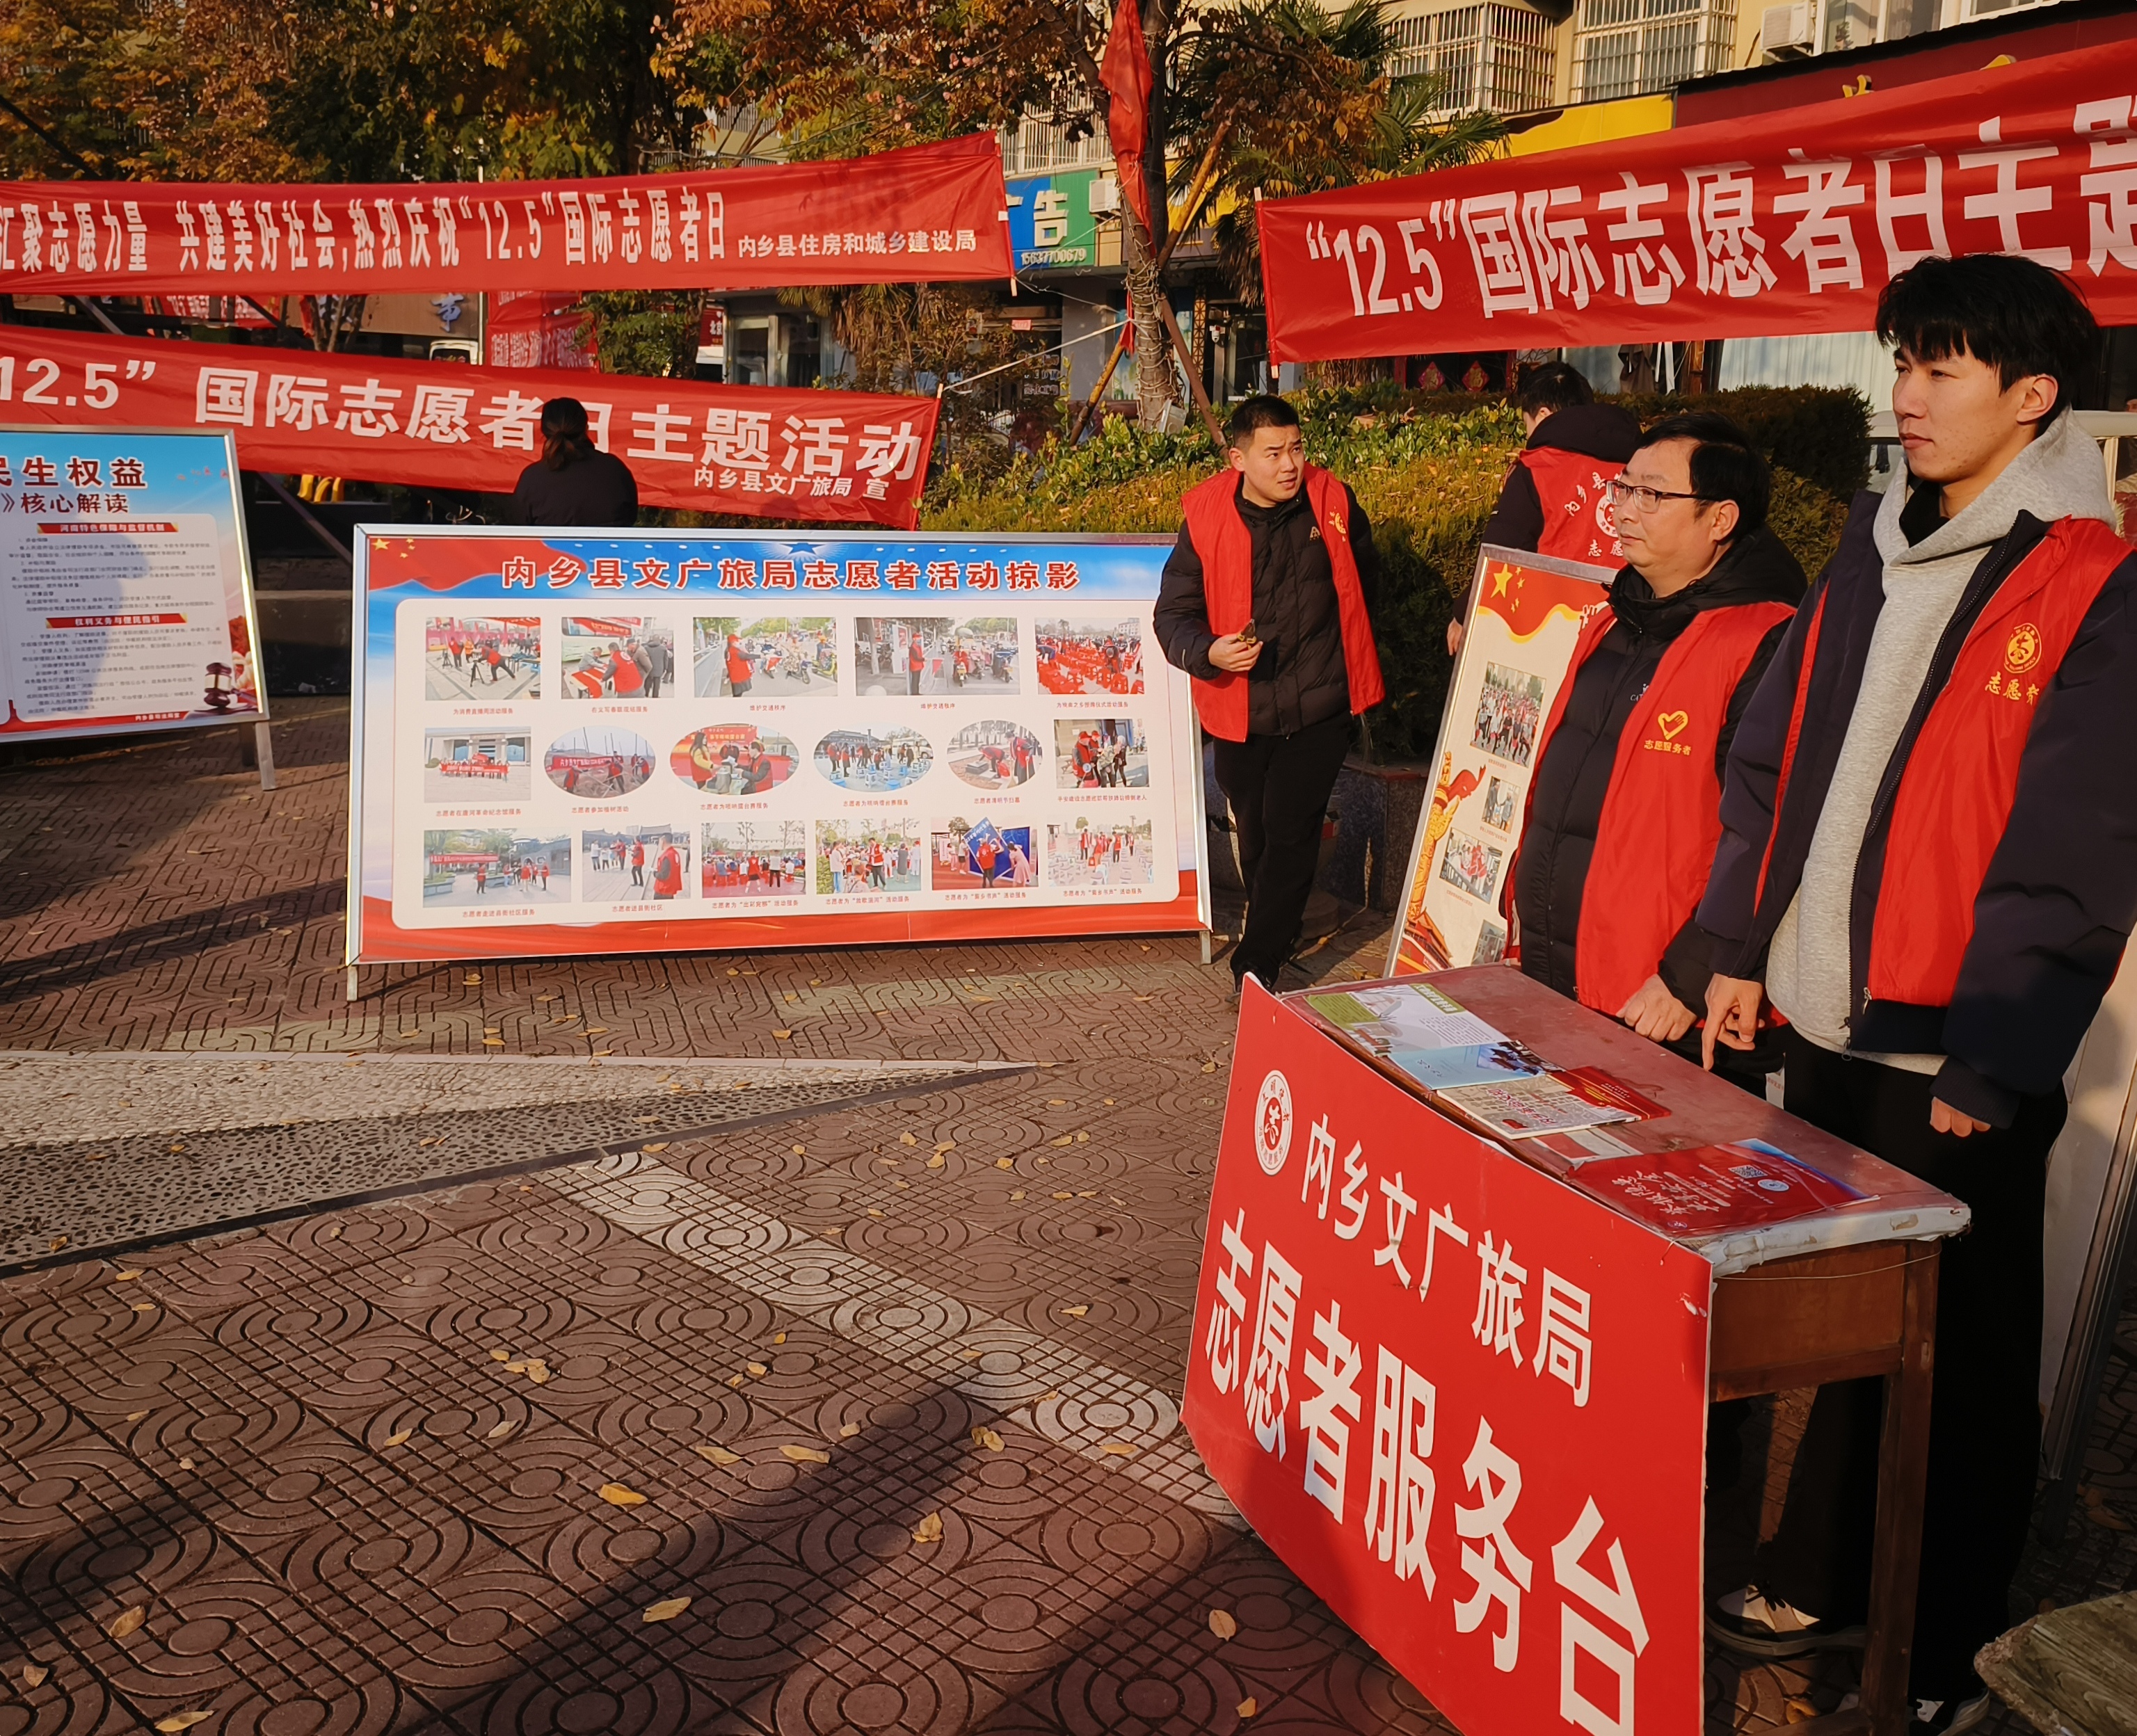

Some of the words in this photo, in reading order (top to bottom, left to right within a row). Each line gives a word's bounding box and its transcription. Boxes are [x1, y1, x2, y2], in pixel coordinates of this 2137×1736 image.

[737, 230, 977, 258] 内乡县住房和城乡建设局
[694, 467, 851, 497] 内乡县文广旅局
[863, 478, 889, 501] 宣
[502, 556, 1080, 590] 内乡县文广旅局志愿者活动掠影
[571, 805, 629, 814] 志愿者参加植树活动
[1300, 1112, 1593, 1407] 内乡文广旅局
[1206, 1207, 1650, 1736] 志愿者服务台
